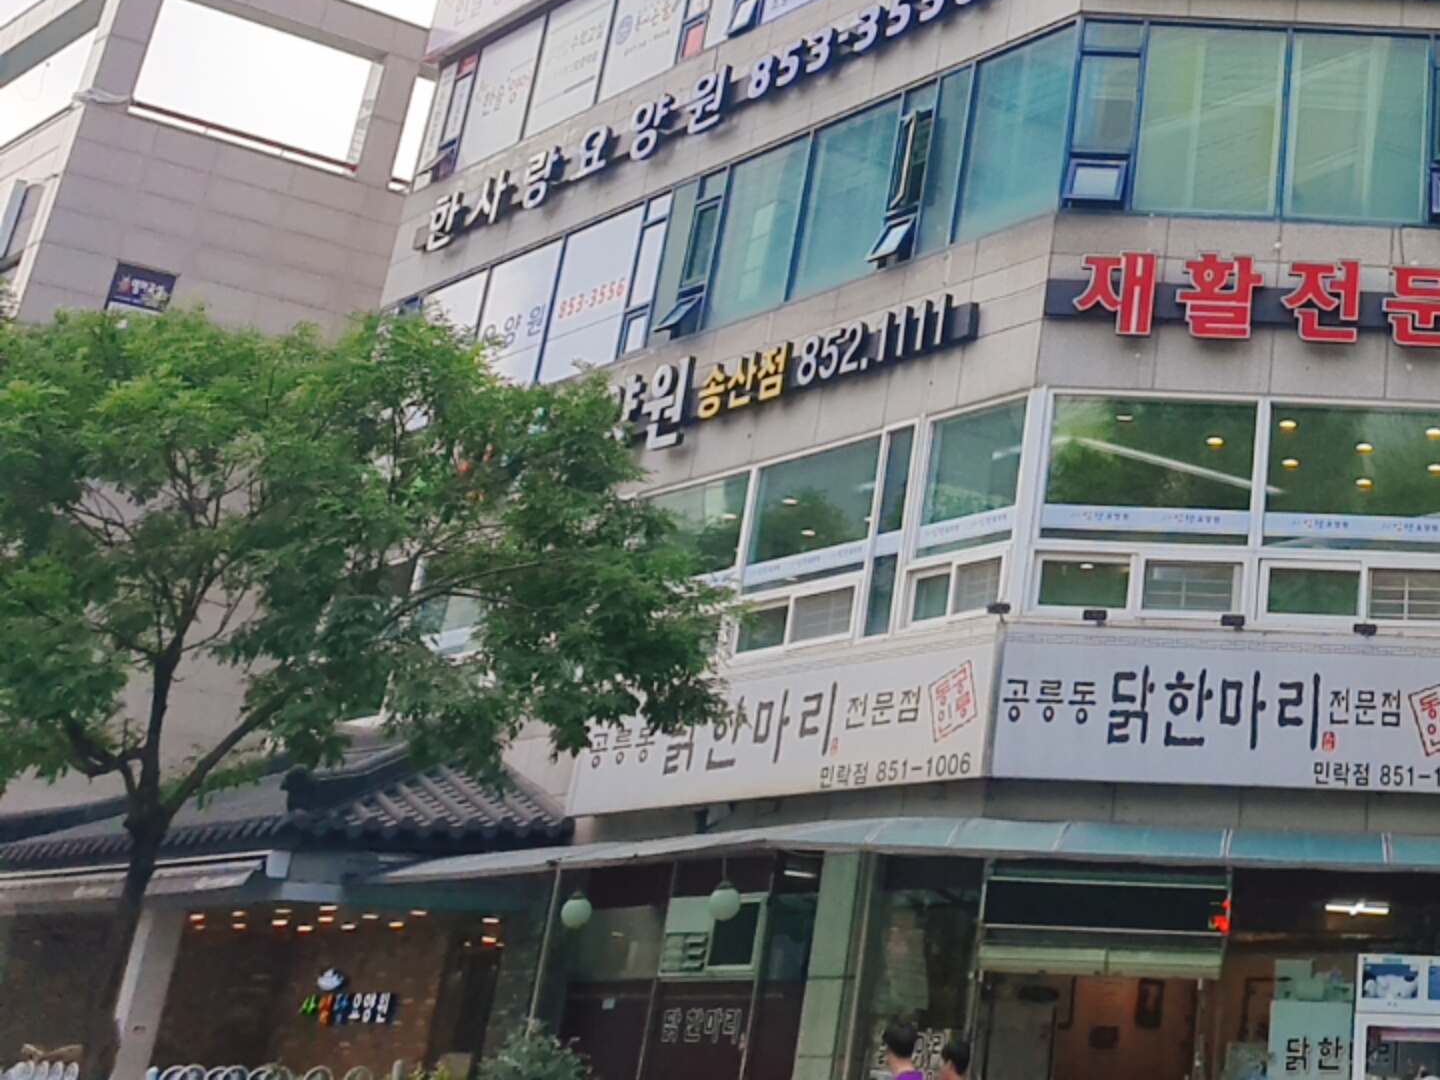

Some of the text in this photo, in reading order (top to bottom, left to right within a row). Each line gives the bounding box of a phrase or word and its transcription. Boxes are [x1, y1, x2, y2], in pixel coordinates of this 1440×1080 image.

[427, 64, 731, 253] 한사랑요양원
[557, 277, 627, 320] 853-3556
[697, 341, 791, 420] 송산점
[796, 294, 950, 385] 852.1111
[845, 686, 922, 730] 전문점
[1002, 664, 1402, 752] 공릉동 닭한마리 전문점
[819, 750, 972, 790] 민락점 851-1006
[1312, 760, 1371, 787] 민락점
